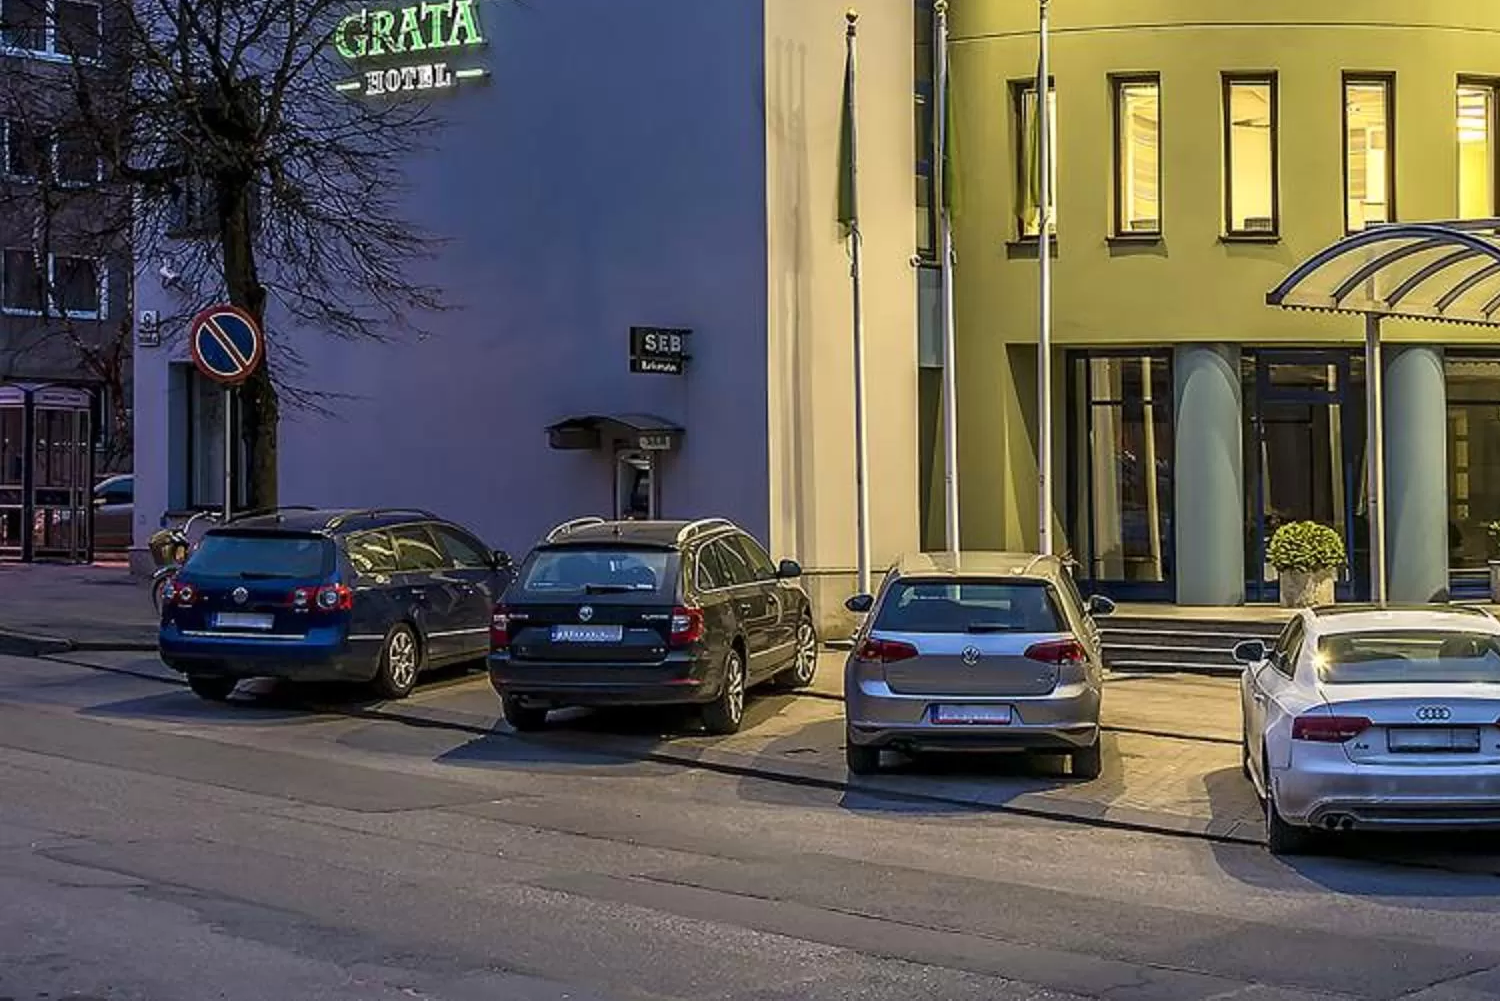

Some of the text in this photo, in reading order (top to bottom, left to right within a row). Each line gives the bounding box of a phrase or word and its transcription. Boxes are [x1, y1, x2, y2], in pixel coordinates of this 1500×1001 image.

[335, 0, 483, 59] GRATA
[365, 62, 452, 96] HOTEL
[645, 333, 681, 352] SEB
